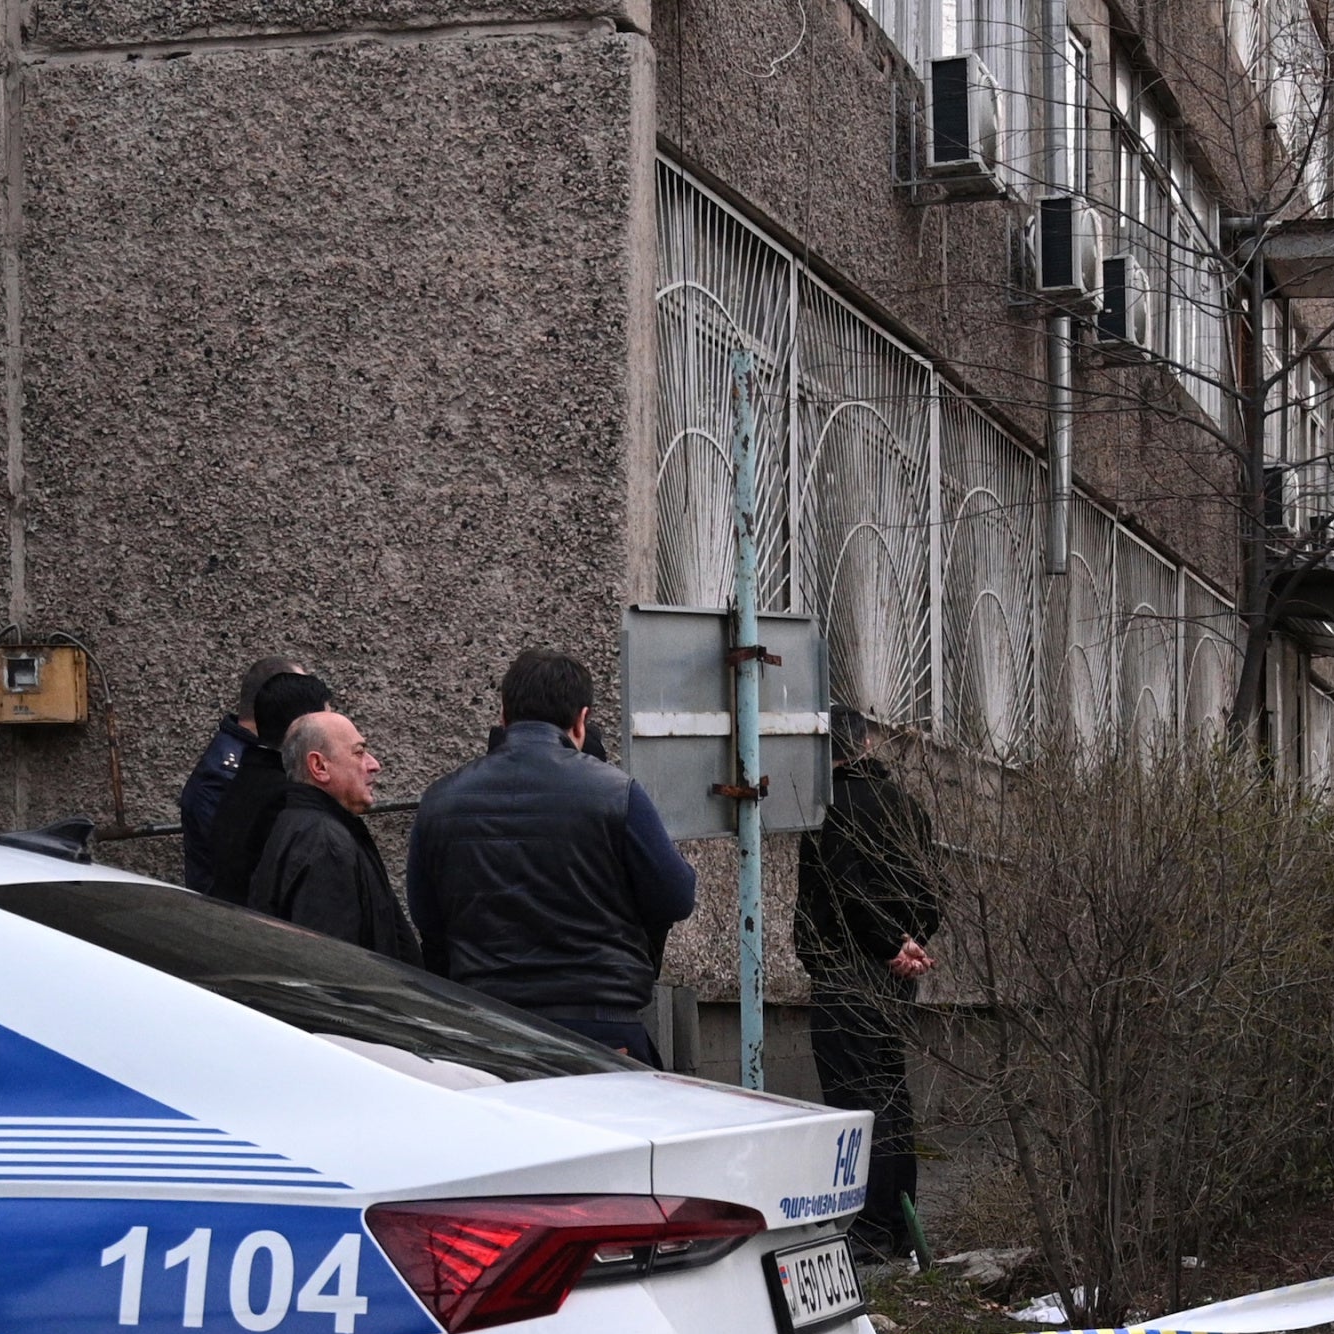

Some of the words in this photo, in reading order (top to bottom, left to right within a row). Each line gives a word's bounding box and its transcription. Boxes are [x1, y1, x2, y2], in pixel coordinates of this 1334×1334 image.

[833, 1127, 863, 1188] 1-02
[99, 1225, 369, 1334] 1104
[795, 1259, 822, 1314] 459
